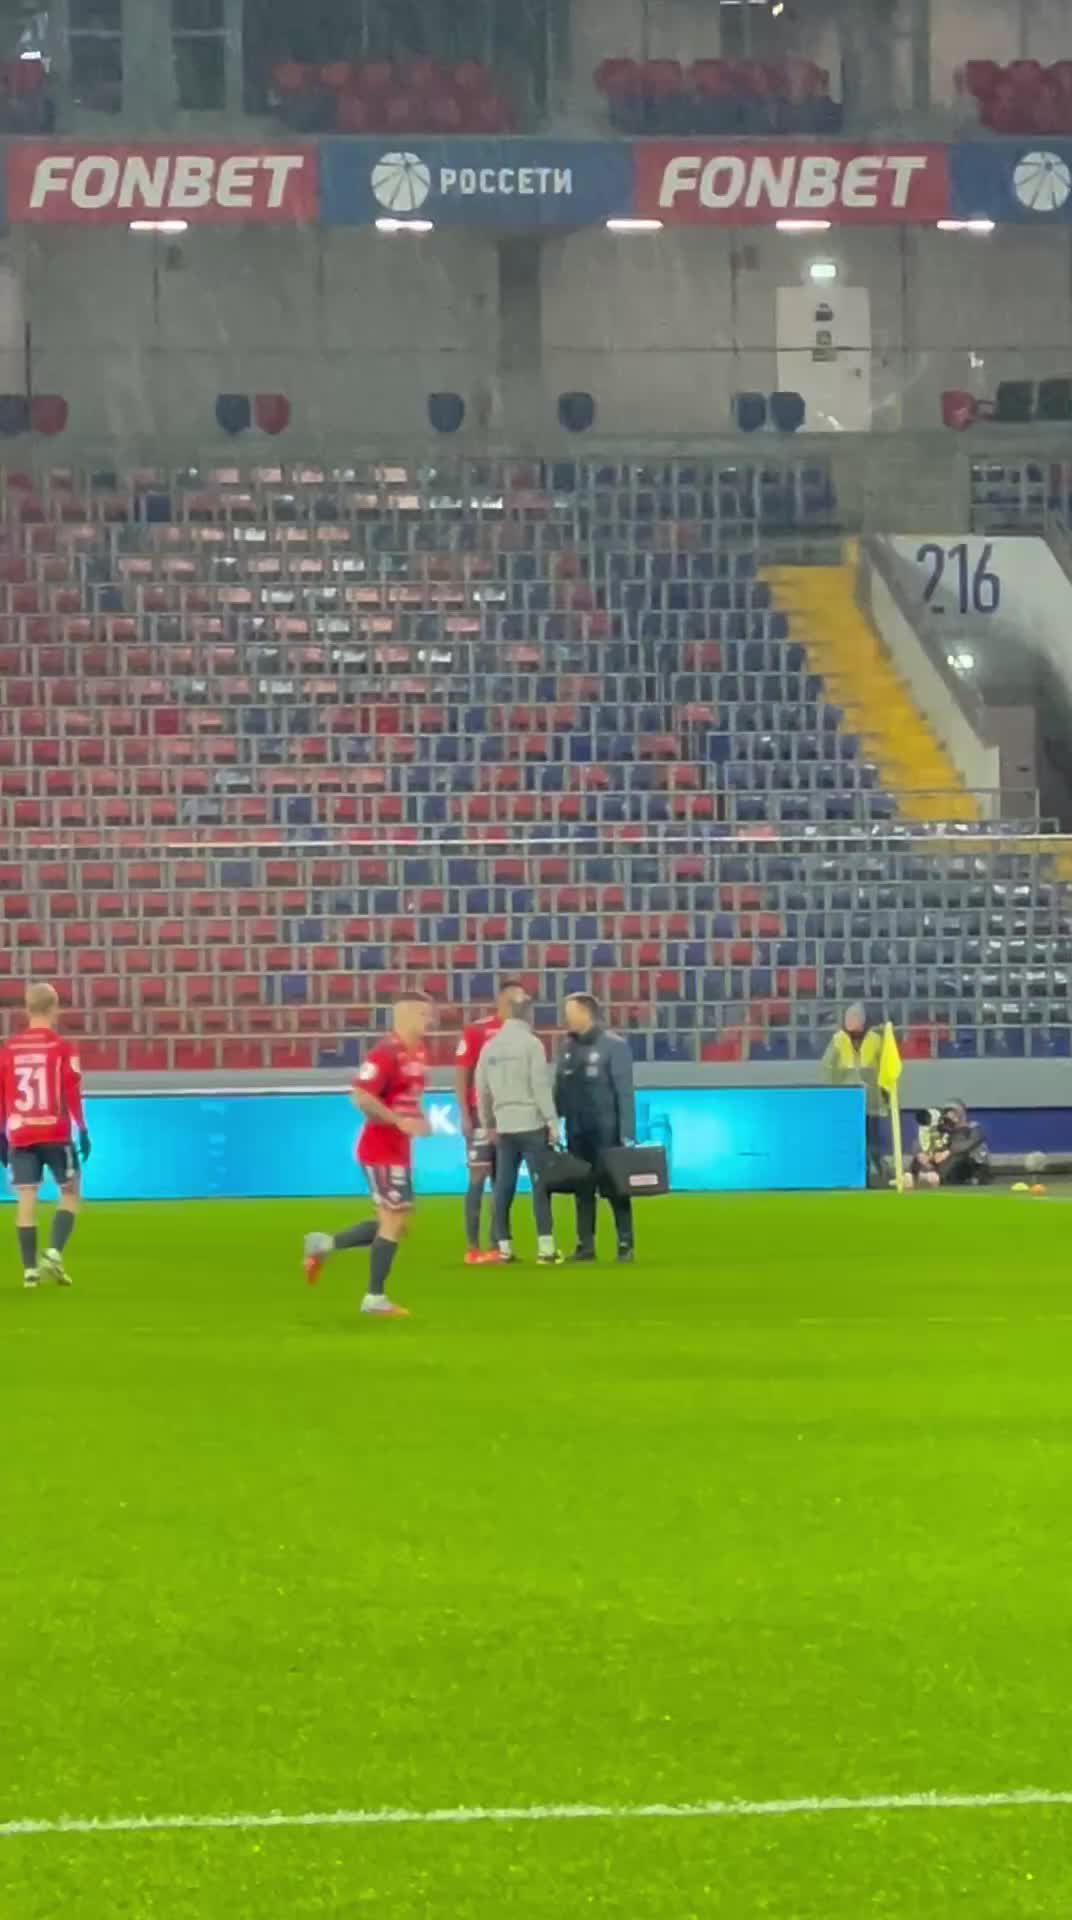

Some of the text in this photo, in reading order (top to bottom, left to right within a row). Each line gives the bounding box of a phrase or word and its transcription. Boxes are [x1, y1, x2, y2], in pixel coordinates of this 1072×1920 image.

[29, 155, 305, 208] FONBET
[440, 167, 573, 195] РОССЕТИ
[659, 155, 928, 209] FONBET
[916, 543, 1000, 614] 216
[14, 1066, 49, 1112] 31
